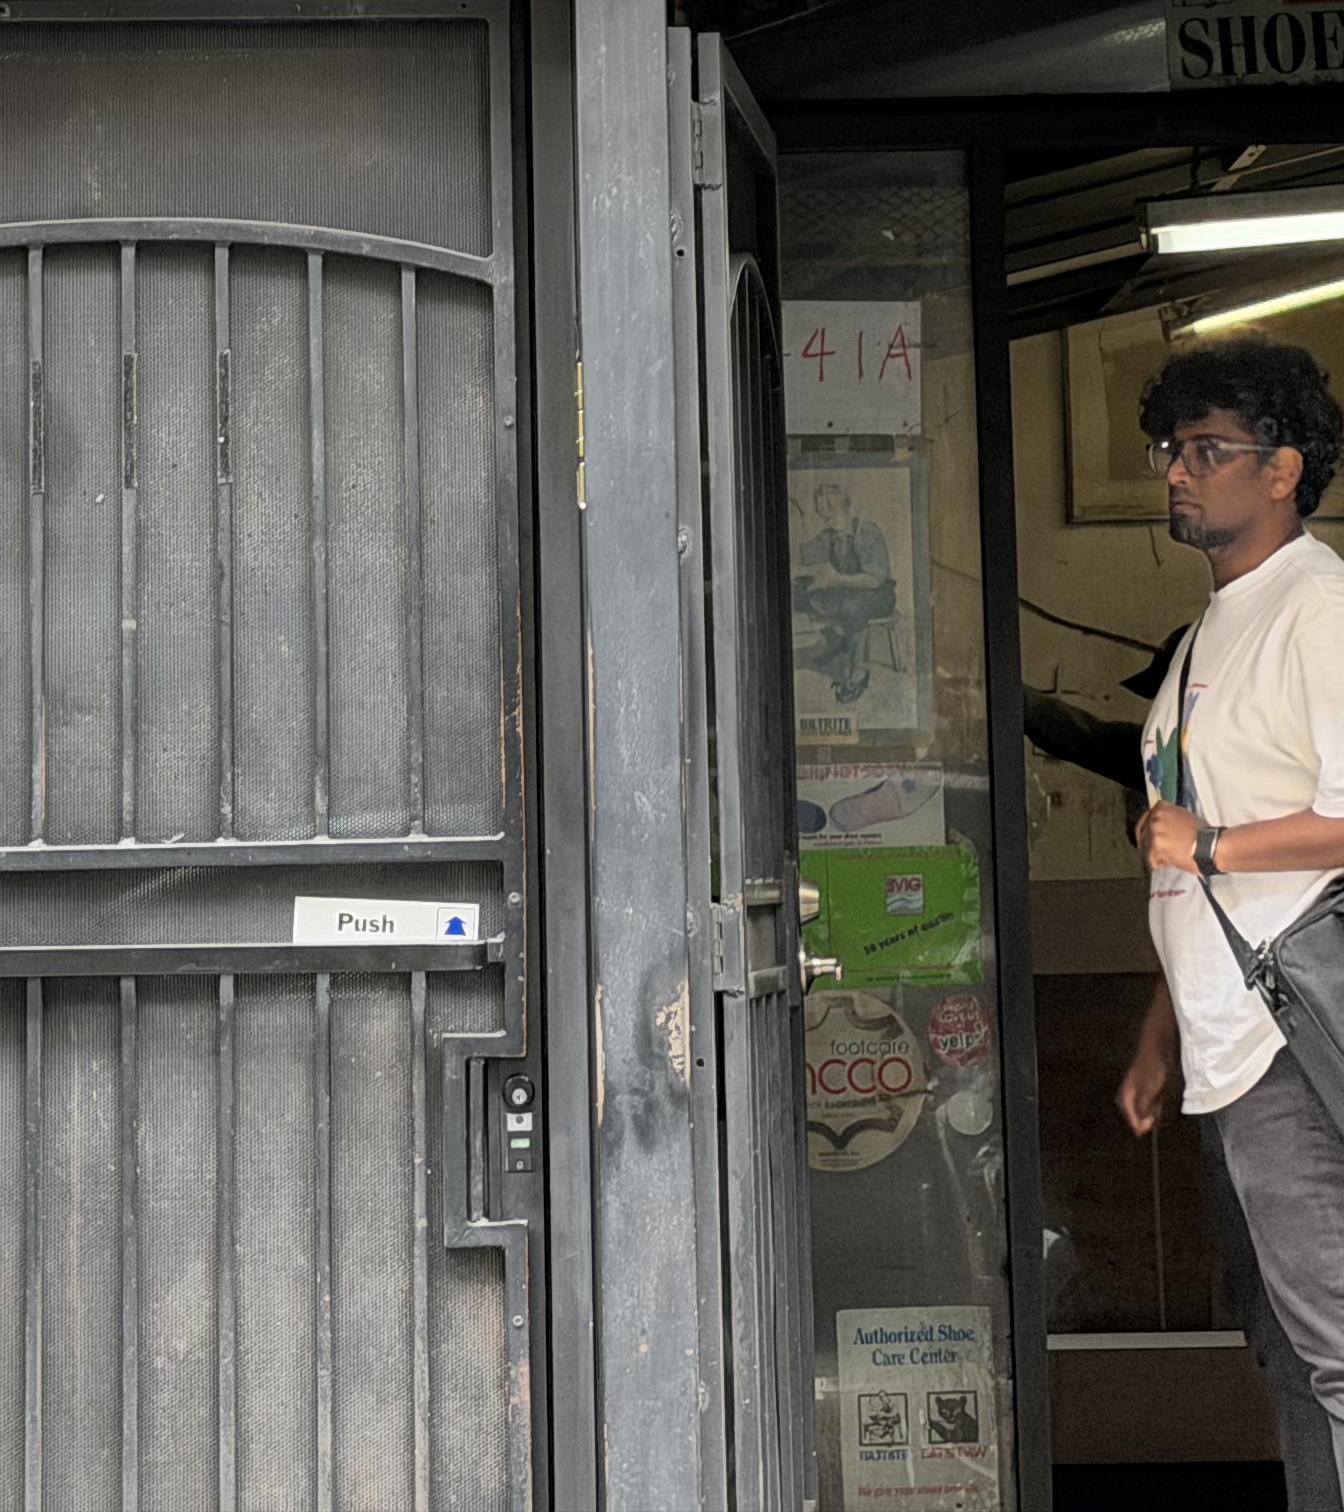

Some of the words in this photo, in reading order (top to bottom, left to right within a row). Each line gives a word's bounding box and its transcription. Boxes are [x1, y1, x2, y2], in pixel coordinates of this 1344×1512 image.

[337, 912, 395, 934] Push
[830, 1039, 910, 1056] footcare
[854, 1326, 933, 1345] Authorized
[937, 1324, 975, 1341] Shoe
[872, 1348, 905, 1366] Care
[909, 1347, 959, 1365] Center
